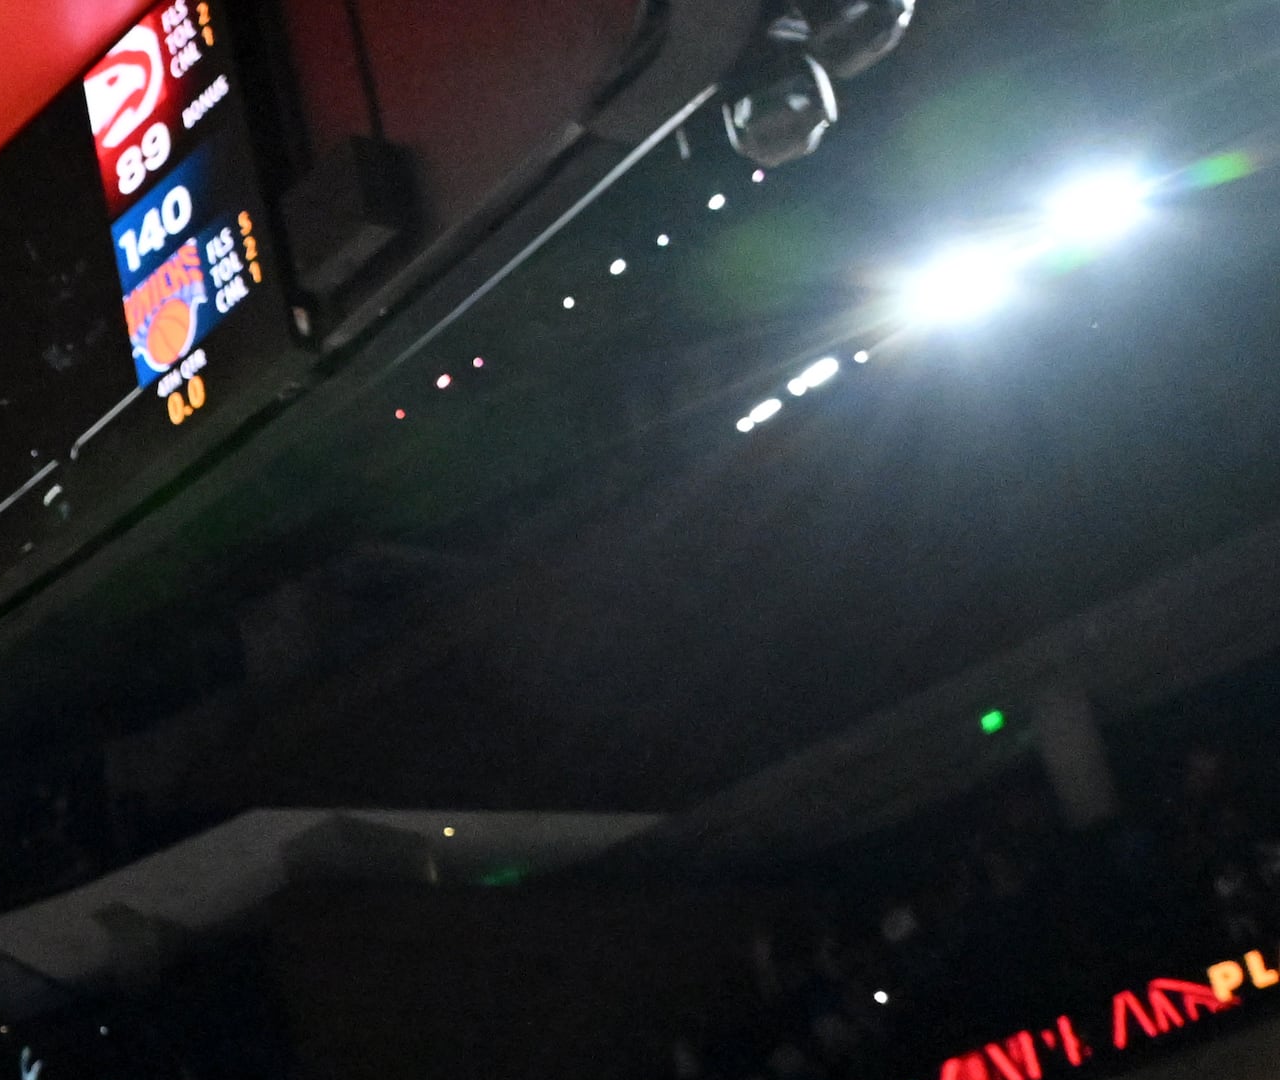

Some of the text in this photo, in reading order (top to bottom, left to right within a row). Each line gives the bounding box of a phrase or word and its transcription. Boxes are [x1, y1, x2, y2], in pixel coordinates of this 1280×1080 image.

[182, 74, 229, 129] BONUS
[116, 122, 171, 195] 89
[119, 185, 192, 272] 140
[206, 227, 234, 264] FLS
[123, 244, 204, 333] KNICKS
[209, 250, 243, 288] TOL
[167, 375, 206, 425] 0.0
